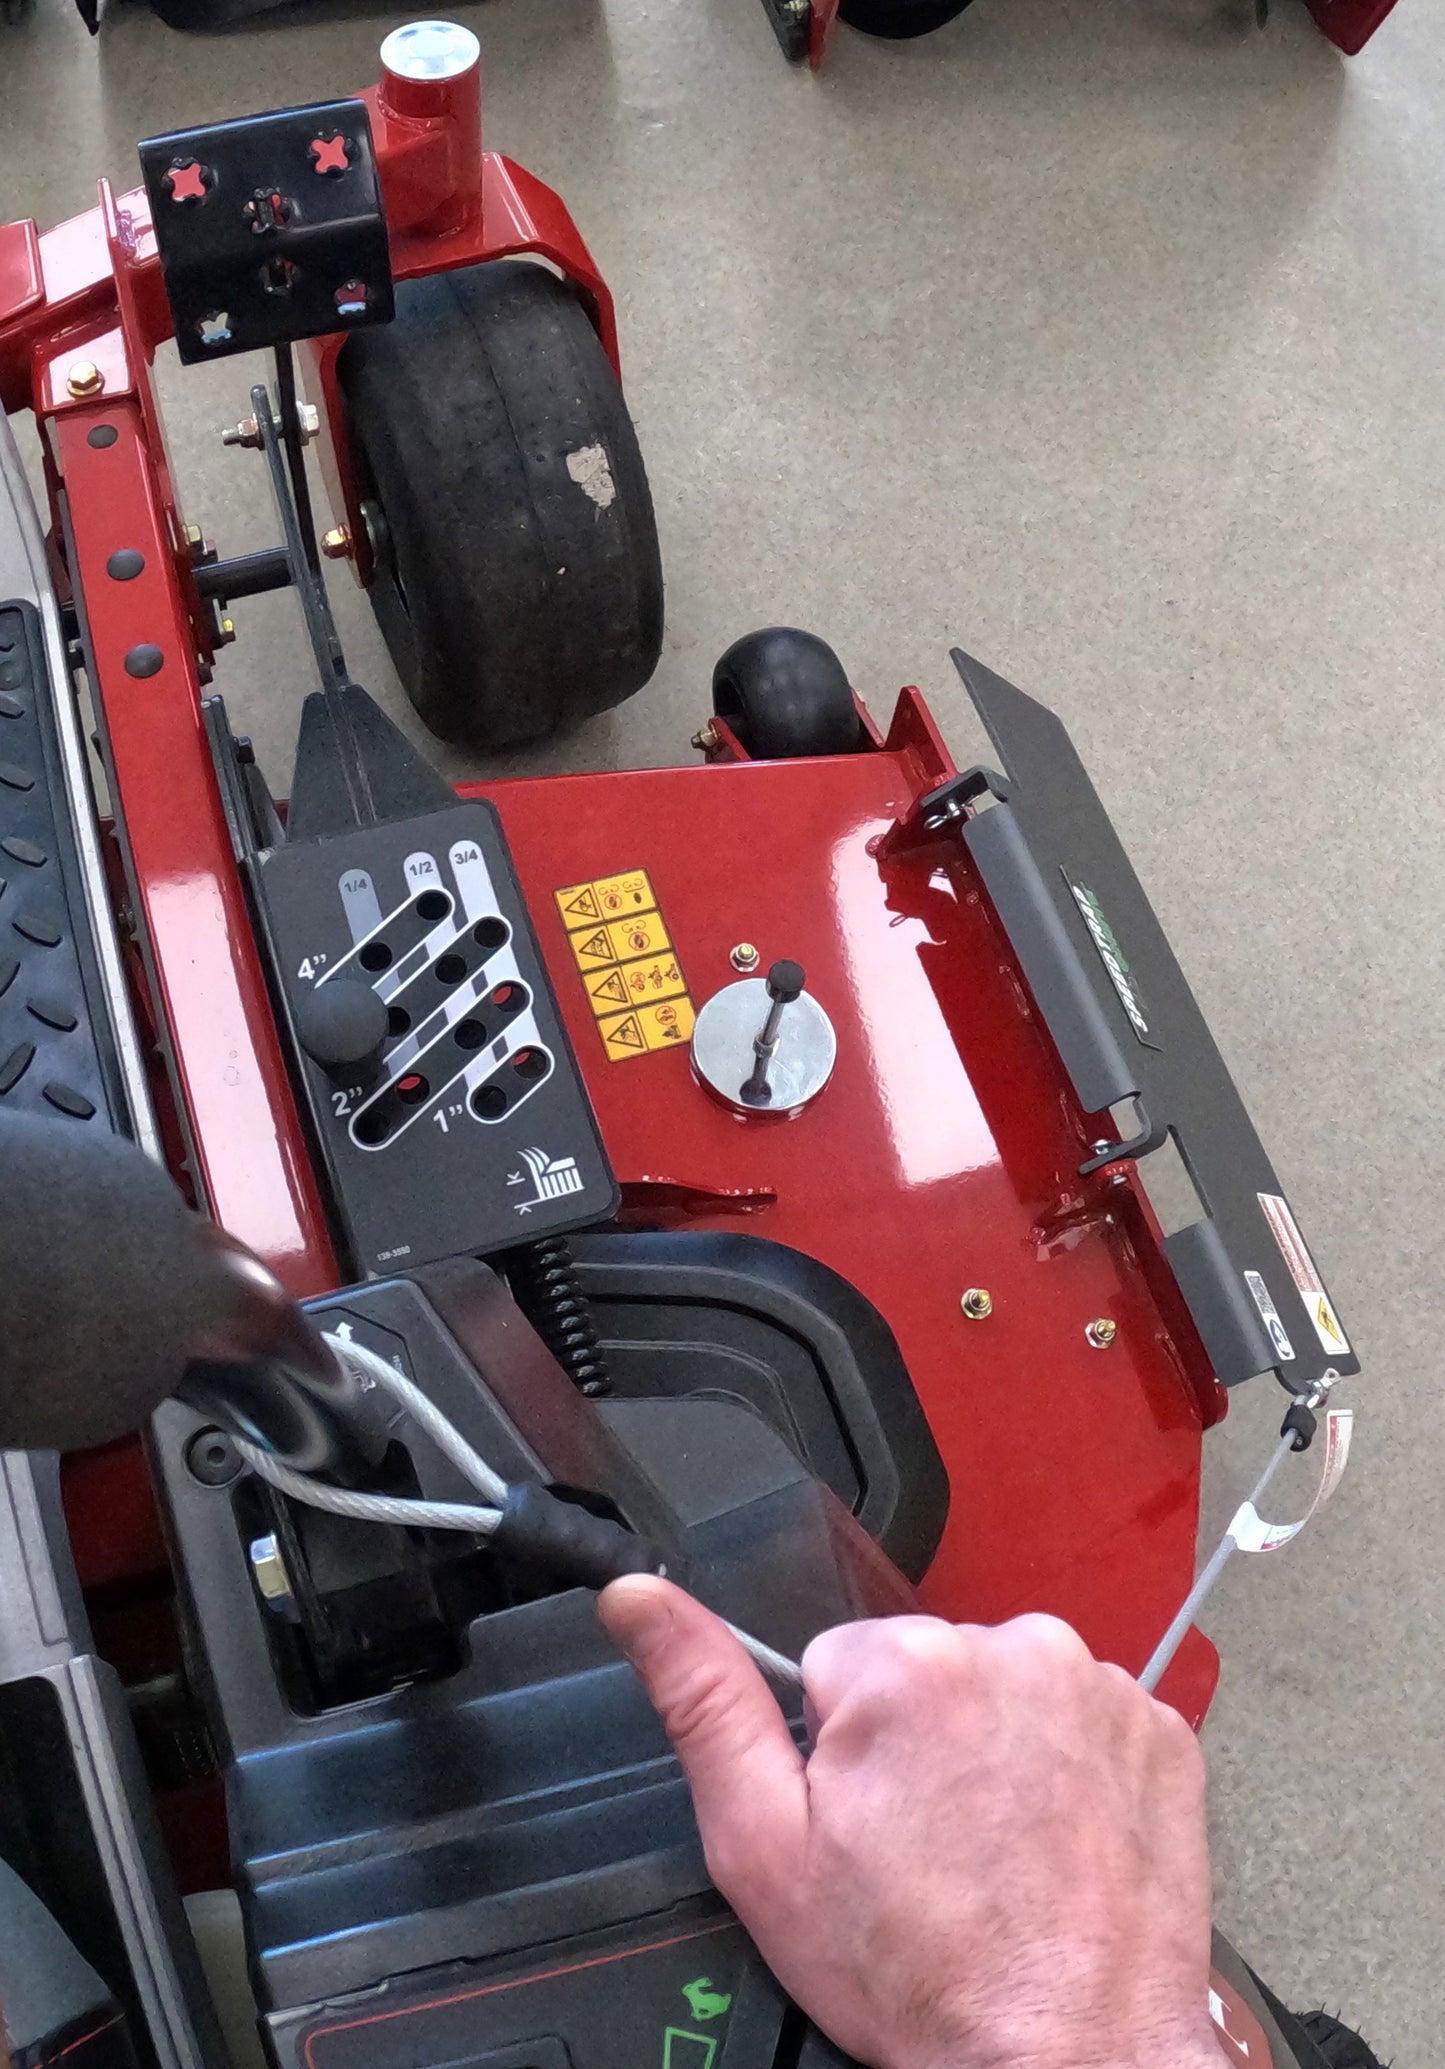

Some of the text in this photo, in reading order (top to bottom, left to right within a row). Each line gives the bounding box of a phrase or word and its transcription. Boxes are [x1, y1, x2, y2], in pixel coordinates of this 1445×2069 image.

[454, 849, 479, 865] 3/4
[409, 861, 434, 876] 1/2
[344, 878, 368, 893] 1/4
